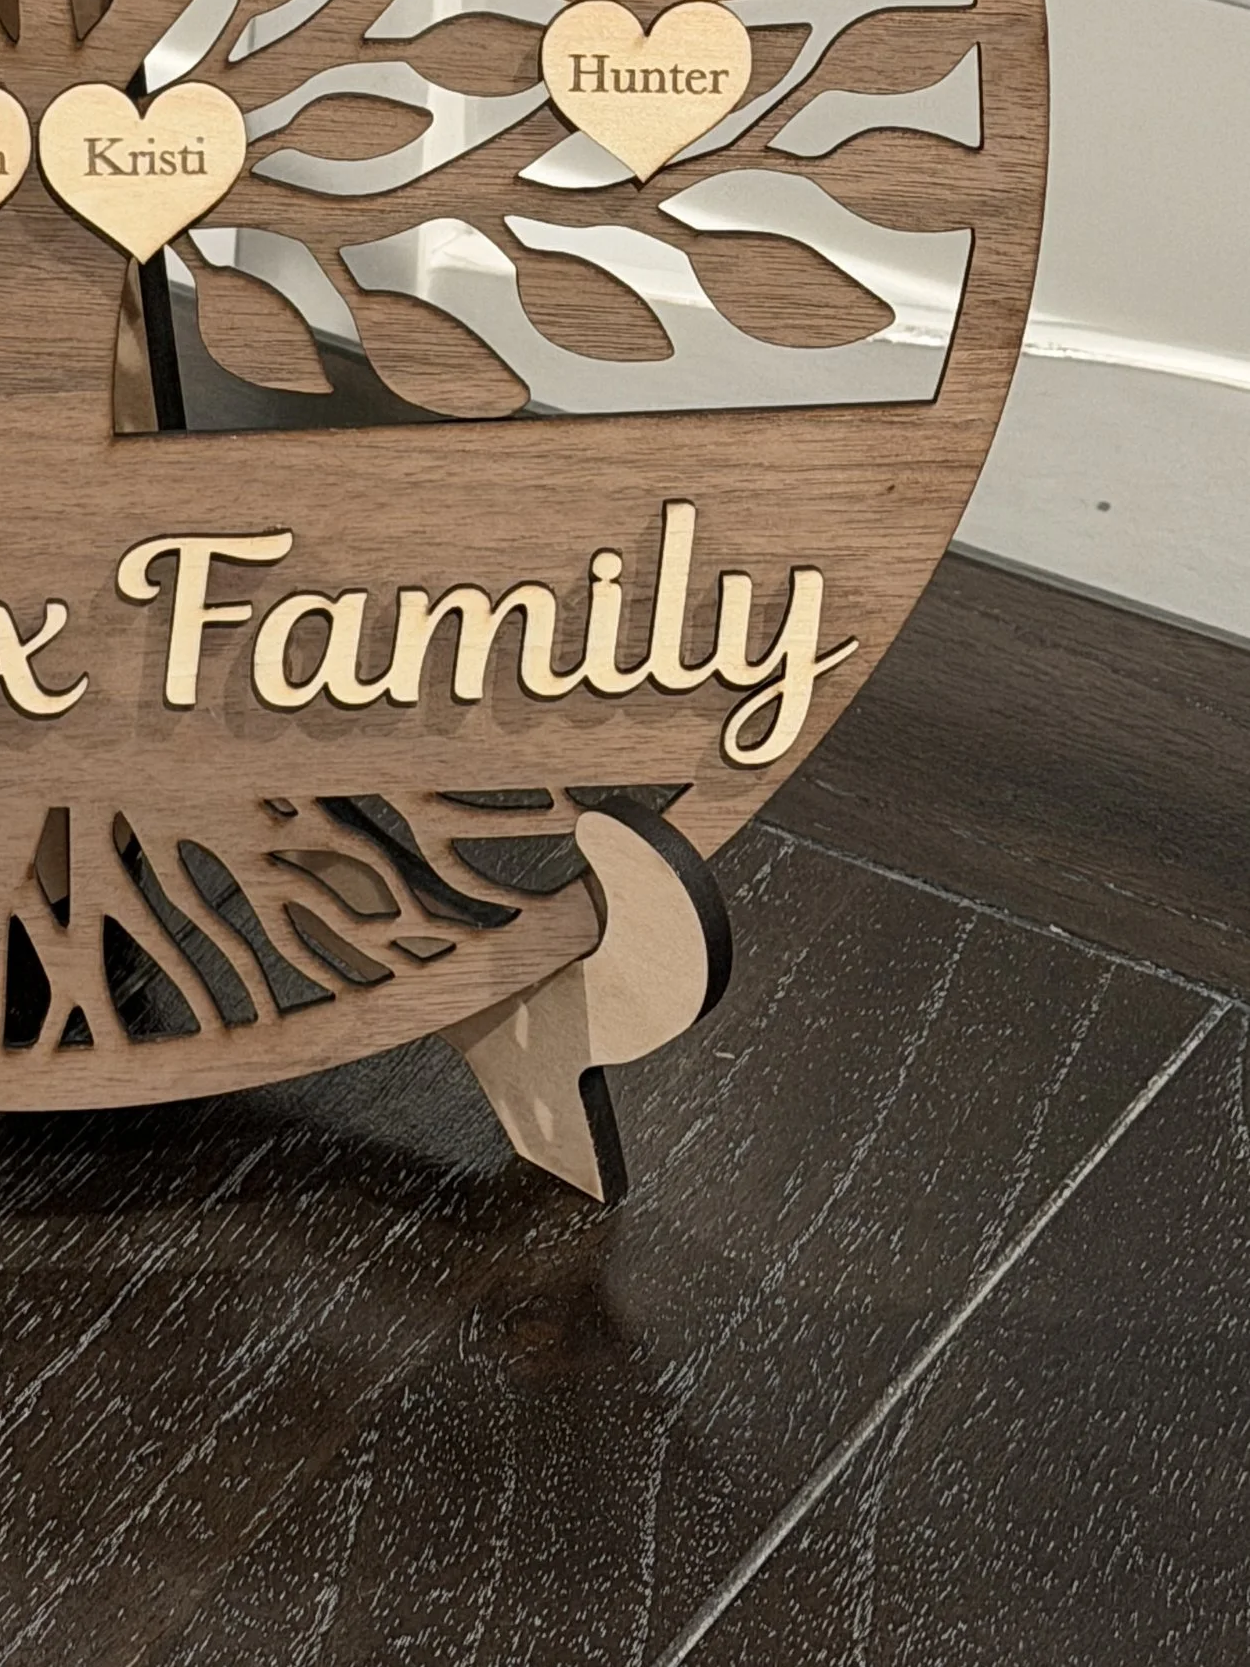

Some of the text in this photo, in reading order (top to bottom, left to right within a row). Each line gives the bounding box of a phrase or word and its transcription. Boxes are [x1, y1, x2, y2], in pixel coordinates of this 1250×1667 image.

[567, 54, 730, 95] Hunter
[83, 136, 208, 177] Kristi
[116, 498, 861, 766] Family
